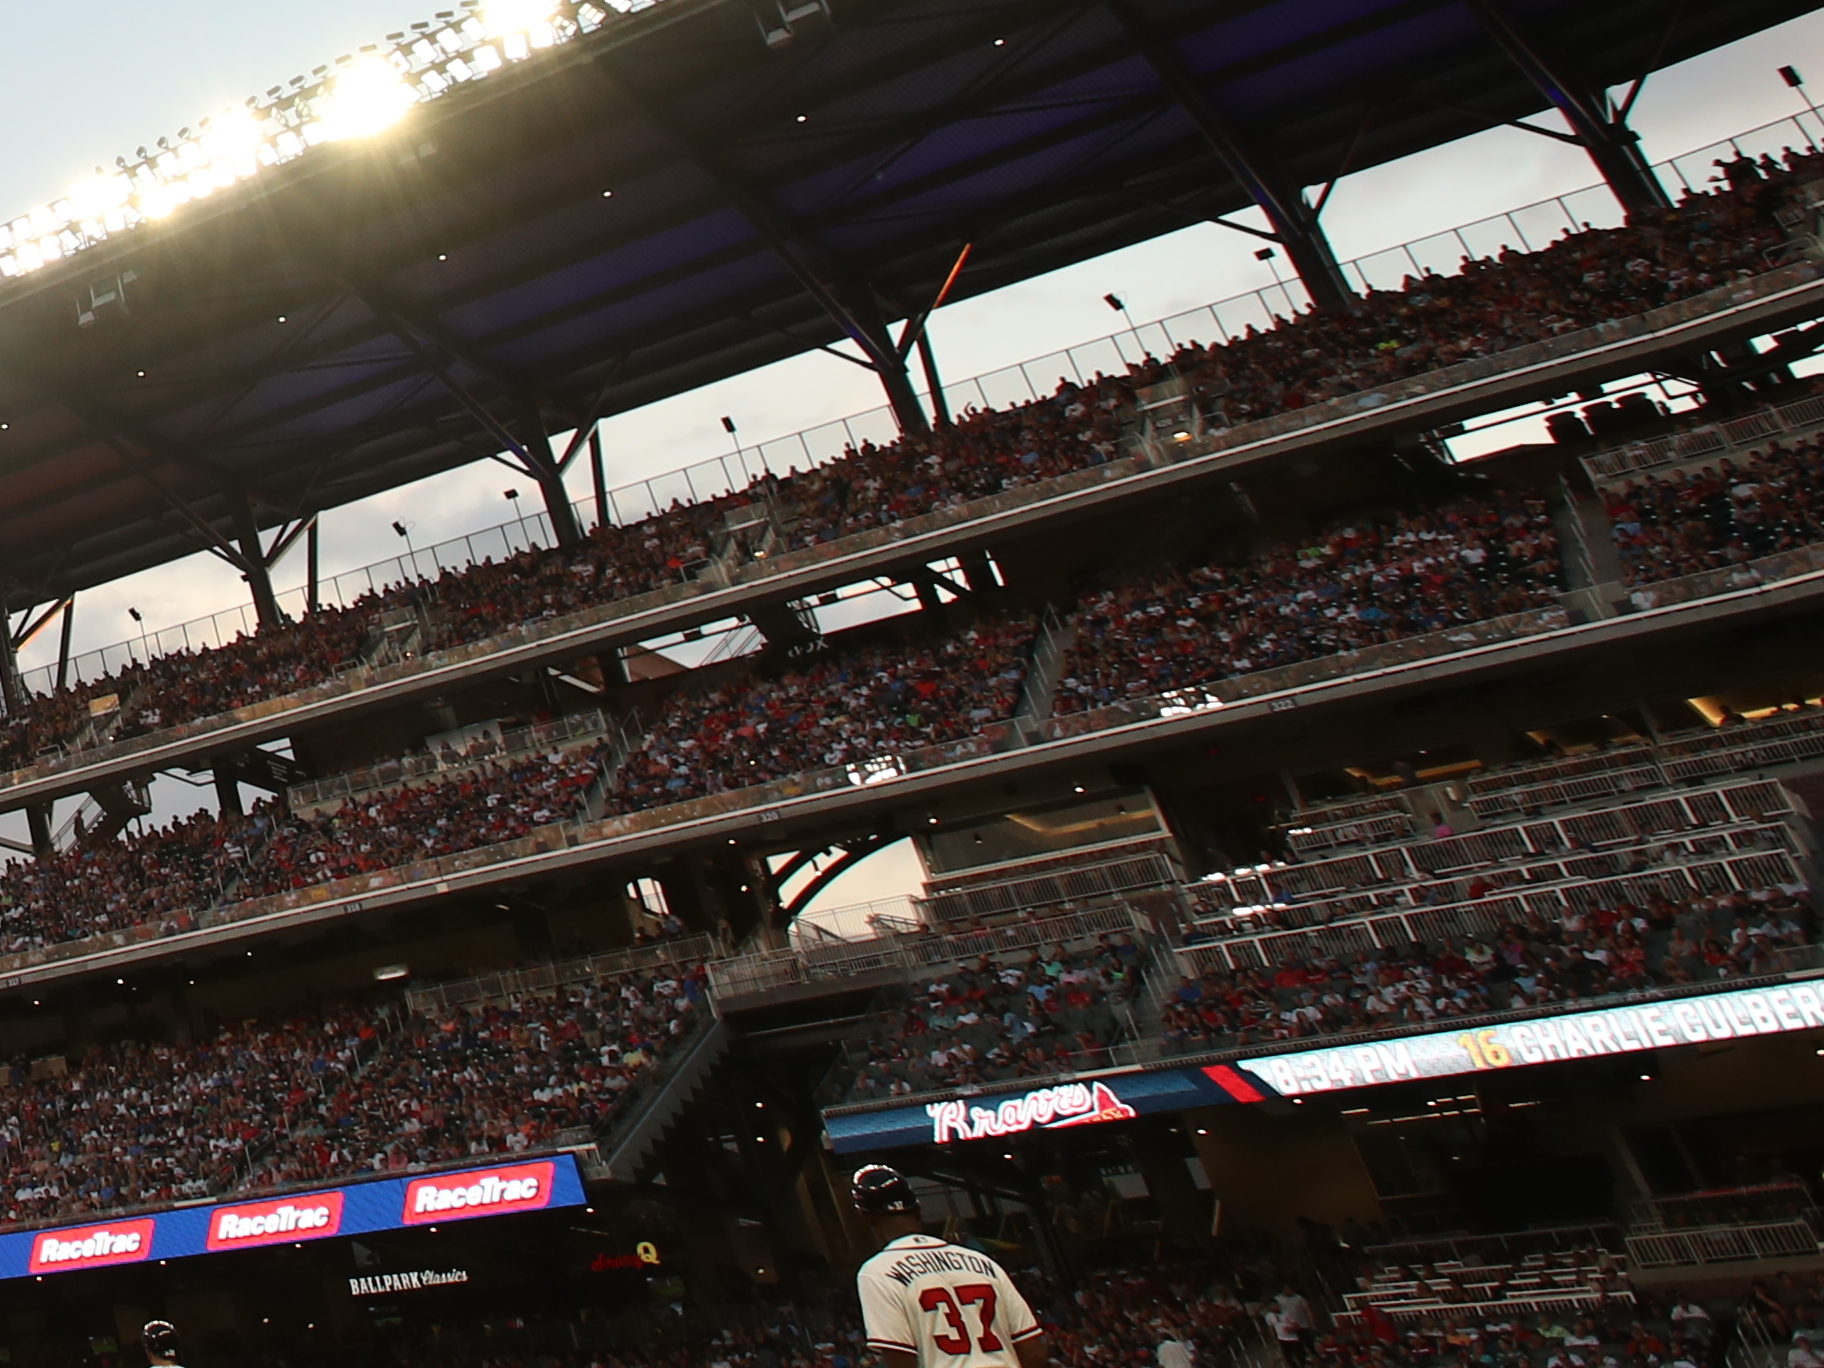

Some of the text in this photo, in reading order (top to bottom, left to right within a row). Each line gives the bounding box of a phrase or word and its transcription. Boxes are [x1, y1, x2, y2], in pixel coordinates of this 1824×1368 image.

[1269, 1052, 1353, 1096] 8:34
[1354, 1042, 1420, 1084] PM
[1457, 1029, 1513, 1069] 16
[1510, 1008, 1675, 1064] CHARLIE
[925, 1082, 1092, 1143] Braves
[415, 1176, 540, 1214] RaceTrac
[218, 1205, 330, 1240] RaceTrac
[39, 1231, 142, 1264] RaceTrac
[349, 1267, 469, 1296] BALLPARK Classics
[885, 1251, 997, 1288] WASHINGTON
[919, 1284, 1004, 1355] 37
